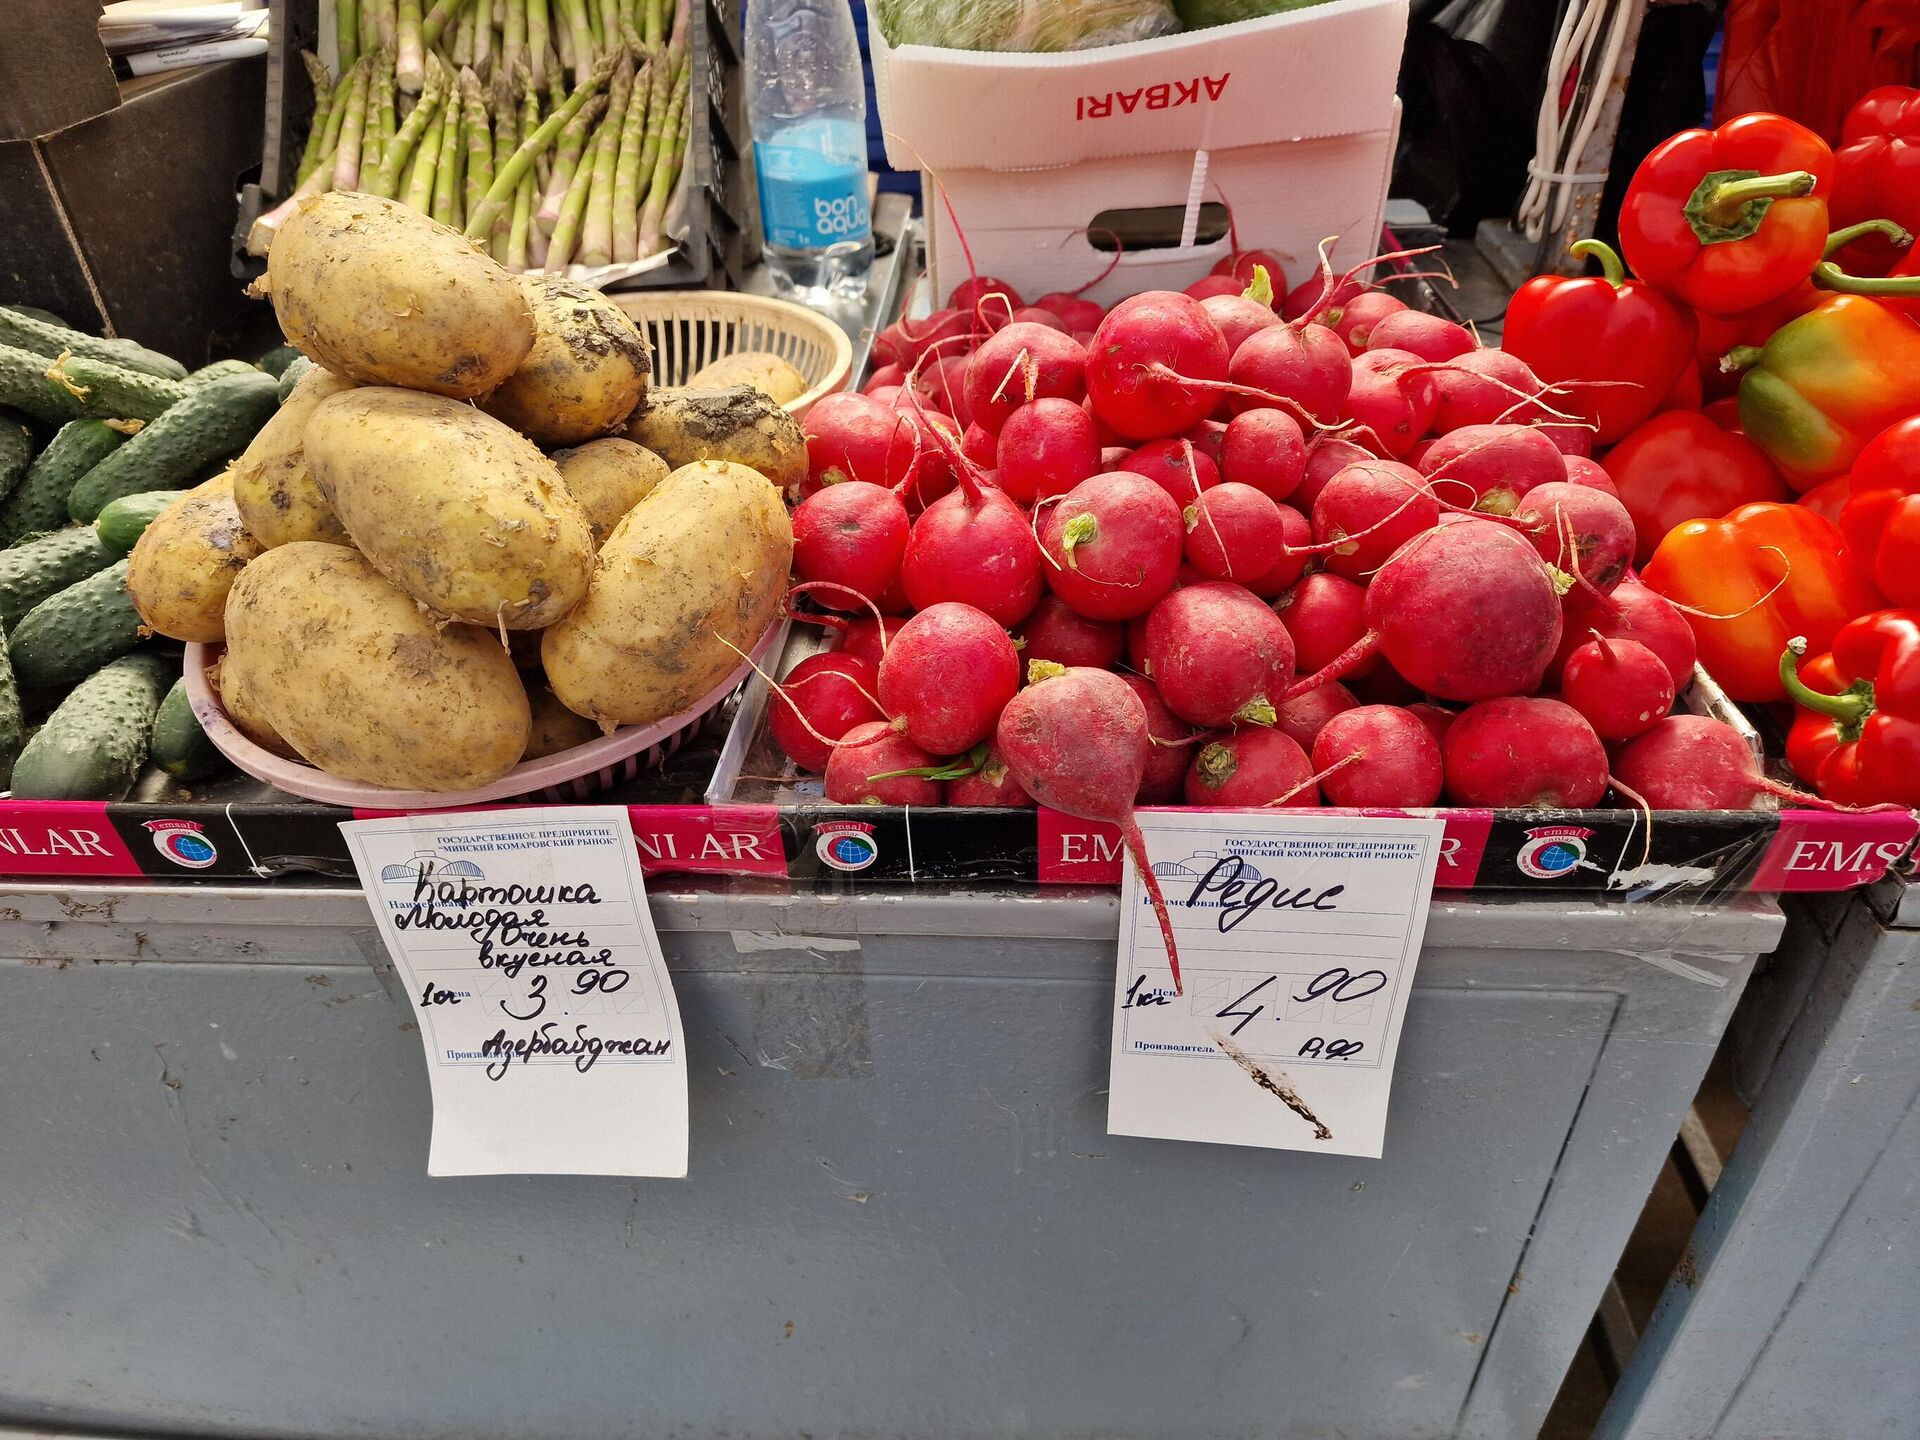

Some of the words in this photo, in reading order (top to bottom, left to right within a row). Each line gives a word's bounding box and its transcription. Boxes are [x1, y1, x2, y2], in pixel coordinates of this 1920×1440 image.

[1076, 72, 1231, 120] AKBARI
[814, 194, 857, 217] bon
[829, 823, 861, 831] emsal
[437, 831, 538, 844] ГОСУДАРСТВЕННОЕ
[539, 829, 612, 839] ПРЕДПРИЯТИЕ
[497, 838, 575, 851] КОМАРОВСКИЙ
[1225, 839, 1334, 850] ГОСУДАРСТВЕННОЕ
[1336, 841, 1417, 851] ПРЕДПРИЯТИЕ
[1287, 850, 1372, 859] КОМАРОВСКИЙ
[414, 861, 602, 909] Картошка
[1188, 855, 1345, 933] Редис
[482, 1023, 670, 1081] Азербайджан
[1134, 1041, 1215, 1053] Производитель
